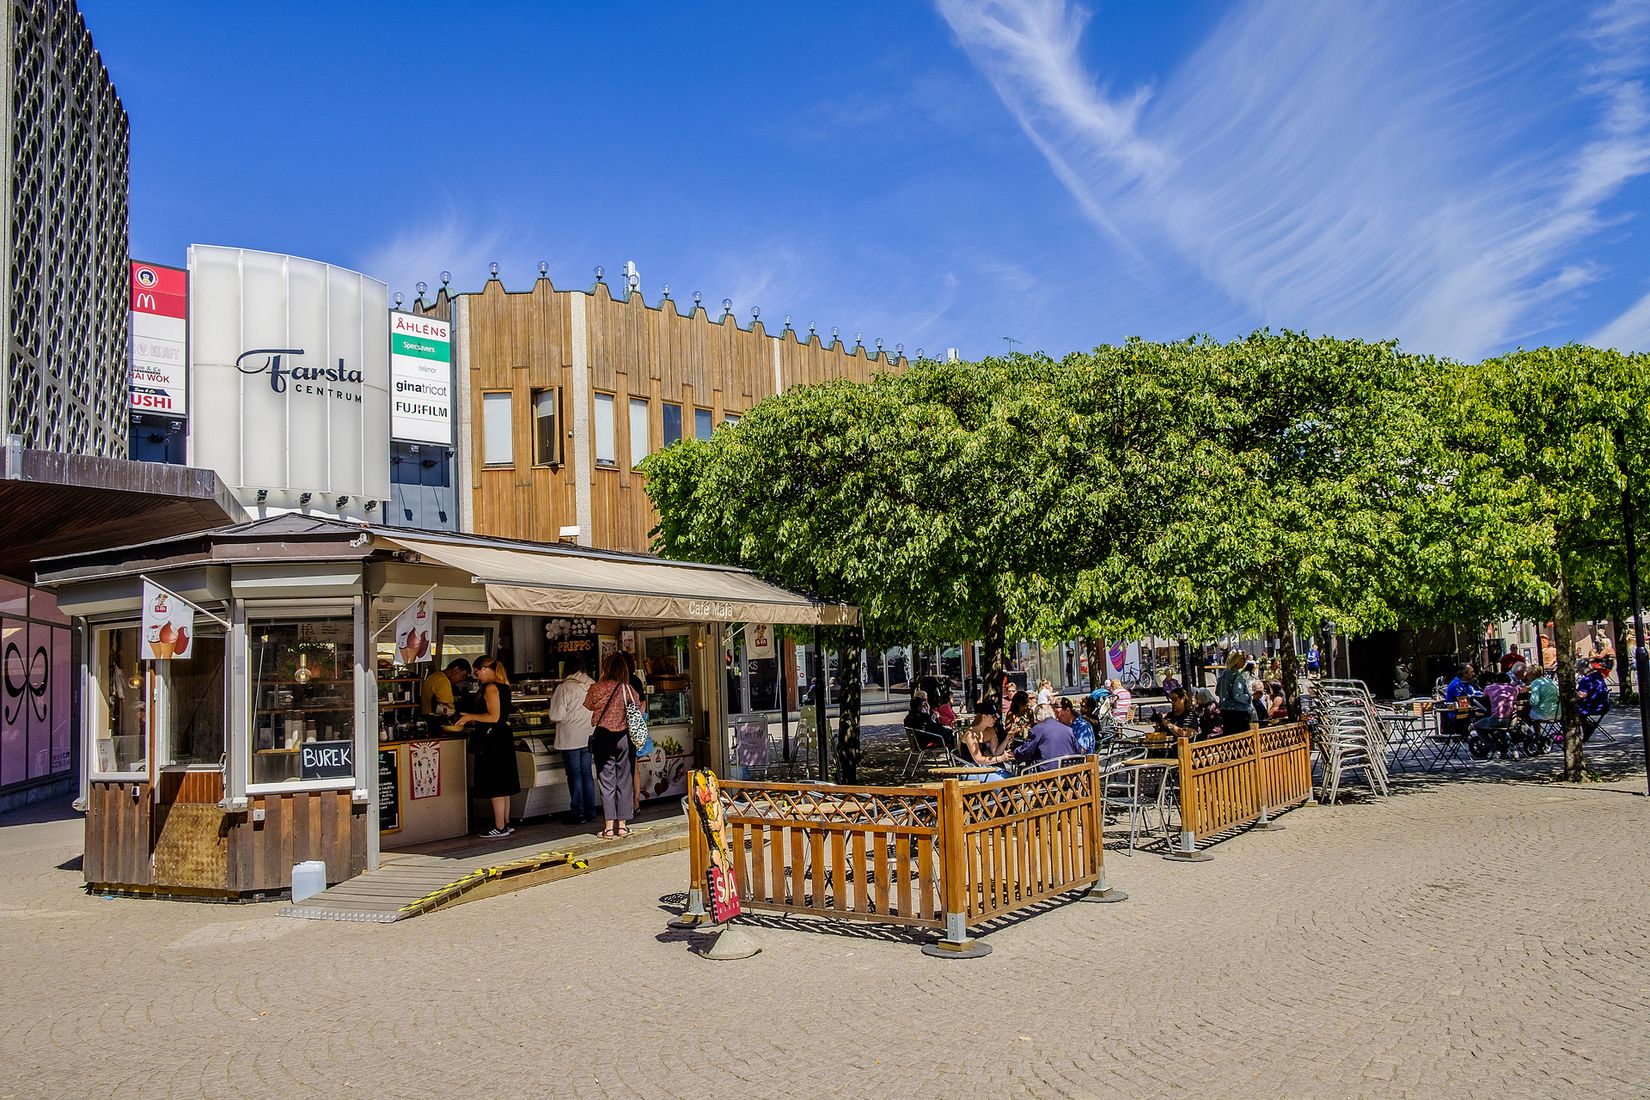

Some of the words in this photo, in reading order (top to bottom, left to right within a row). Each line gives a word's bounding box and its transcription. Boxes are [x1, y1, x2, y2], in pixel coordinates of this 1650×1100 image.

[396, 317, 447, 337] ÅHLÉNS
[128, 371, 145, 380] HAI
[147, 374, 170, 383] WOK
[235, 349, 364, 393] Farsta
[130, 393, 172, 409] USHI
[295, 384, 362, 403] CENTRUM
[396, 401, 448, 417] FUJIFILM
[689, 600, 710, 615] Café
[557, 640, 592, 652] PRIPPS
[303, 748, 352, 767] BUREK
